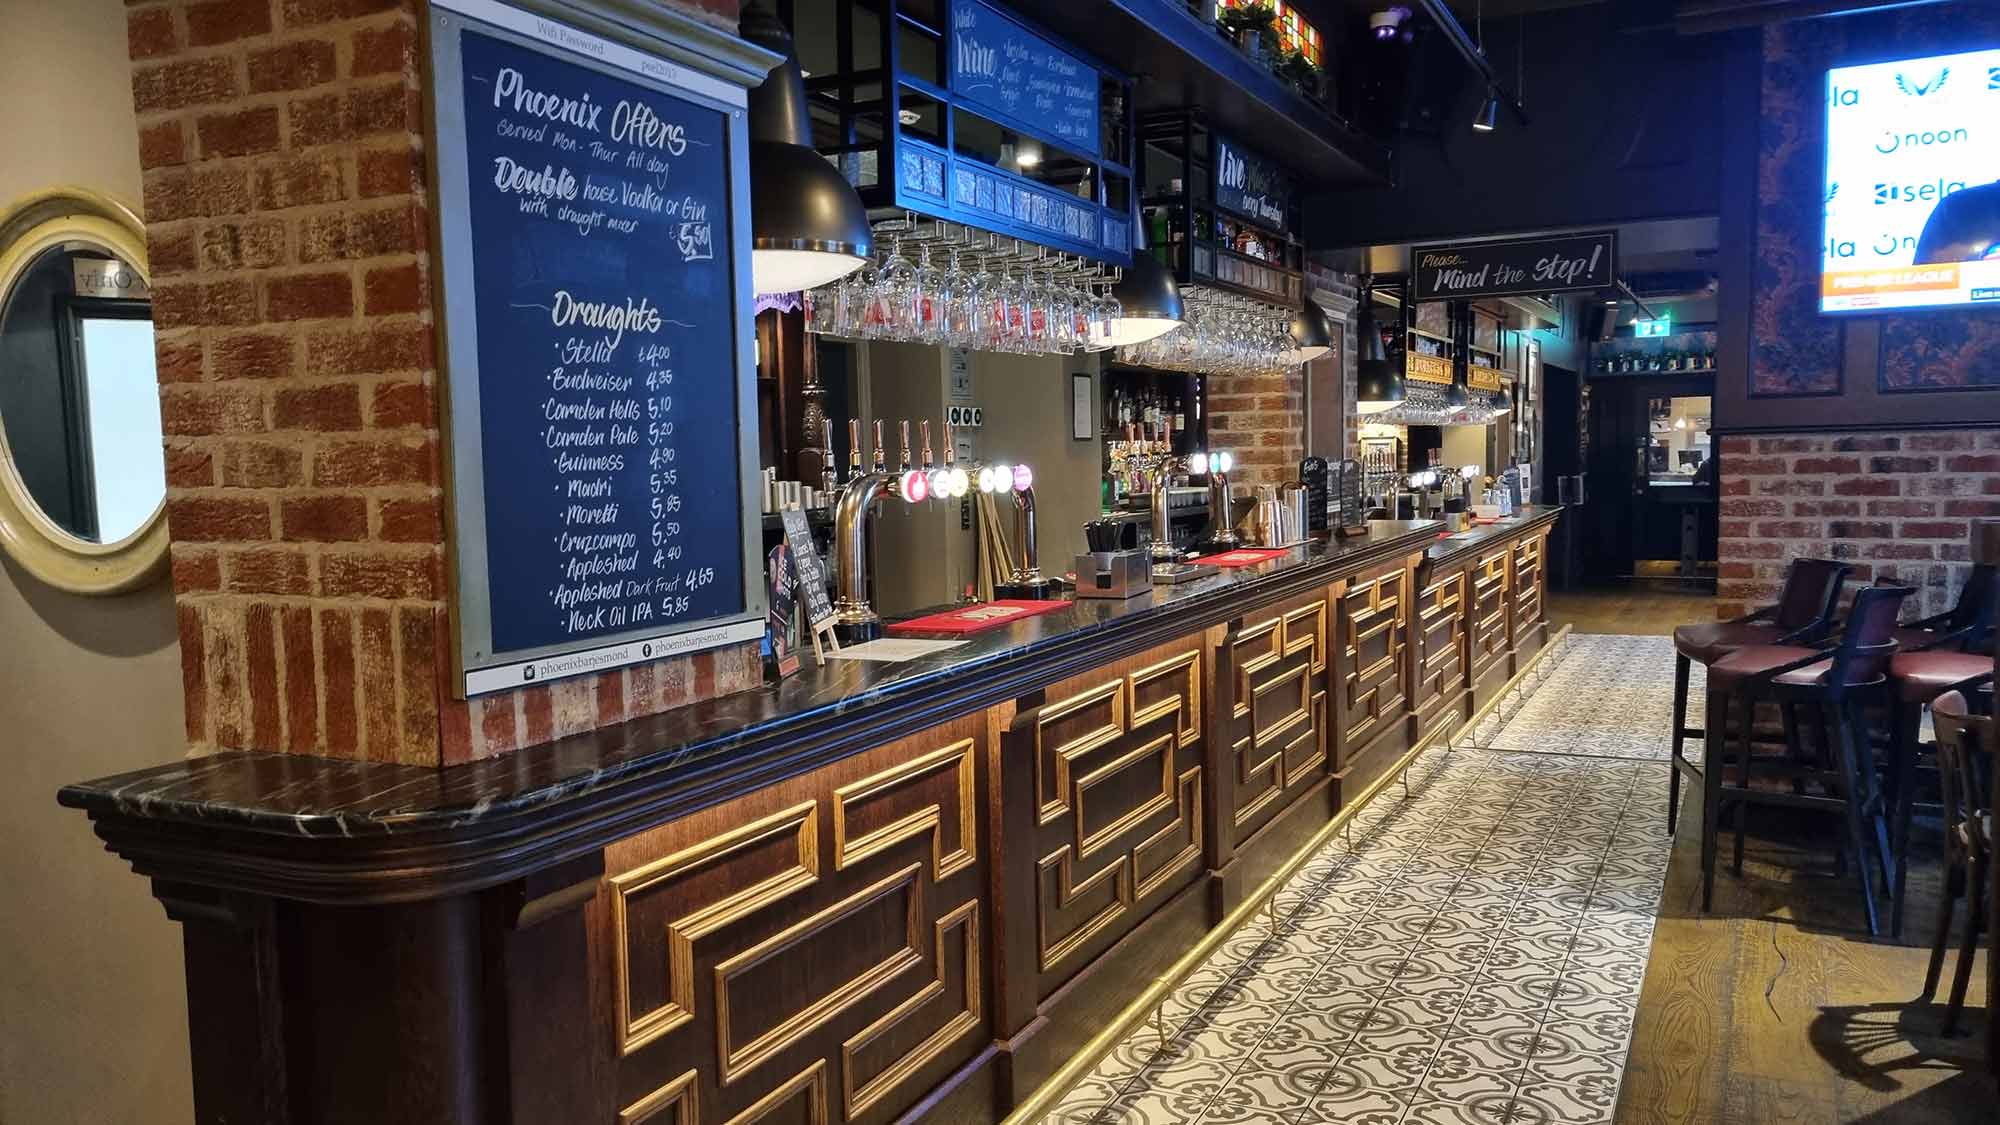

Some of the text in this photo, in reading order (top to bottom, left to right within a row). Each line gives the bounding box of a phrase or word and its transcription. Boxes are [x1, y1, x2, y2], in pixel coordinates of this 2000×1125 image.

[493, 67, 687, 156] Phoenix Offers
[497, 119, 548, 143] Served
[589, 141, 618, 162] Thur
[626, 152, 643, 169] All
[647, 156, 669, 190] day
[1905, 128, 1967, 148] noon
[494, 157, 706, 220] Double house Vodka or Gin
[520, 196, 548, 218] with
[557, 205, 606, 236] draught
[1433, 244, 1602, 292] Mind the Step!
[552, 290, 662, 350] Draughts
[562, 337, 613, 364] Stella
[553, 366, 673, 392] Budweiser 4.35
[545, 395, 672, 420] Camden Hells 5.10
[546, 422, 673, 448] Camden Pale 5.20
[558, 447, 675, 474] Guinness 4.90
[568, 469, 677, 498] Madri 5.35
[566, 494, 681, 525] Moretti 5.85
[560, 521, 681, 555] Cruzcampo 5.50
[567, 545, 682, 581] Appleshed 4.40
[554, 567, 714, 610] Appleshed Dark Fruit 4.65
[568, 596, 689, 632] Neck Oil IPA 5.85
[540, 647, 629, 678] phoenixbarjesmond
